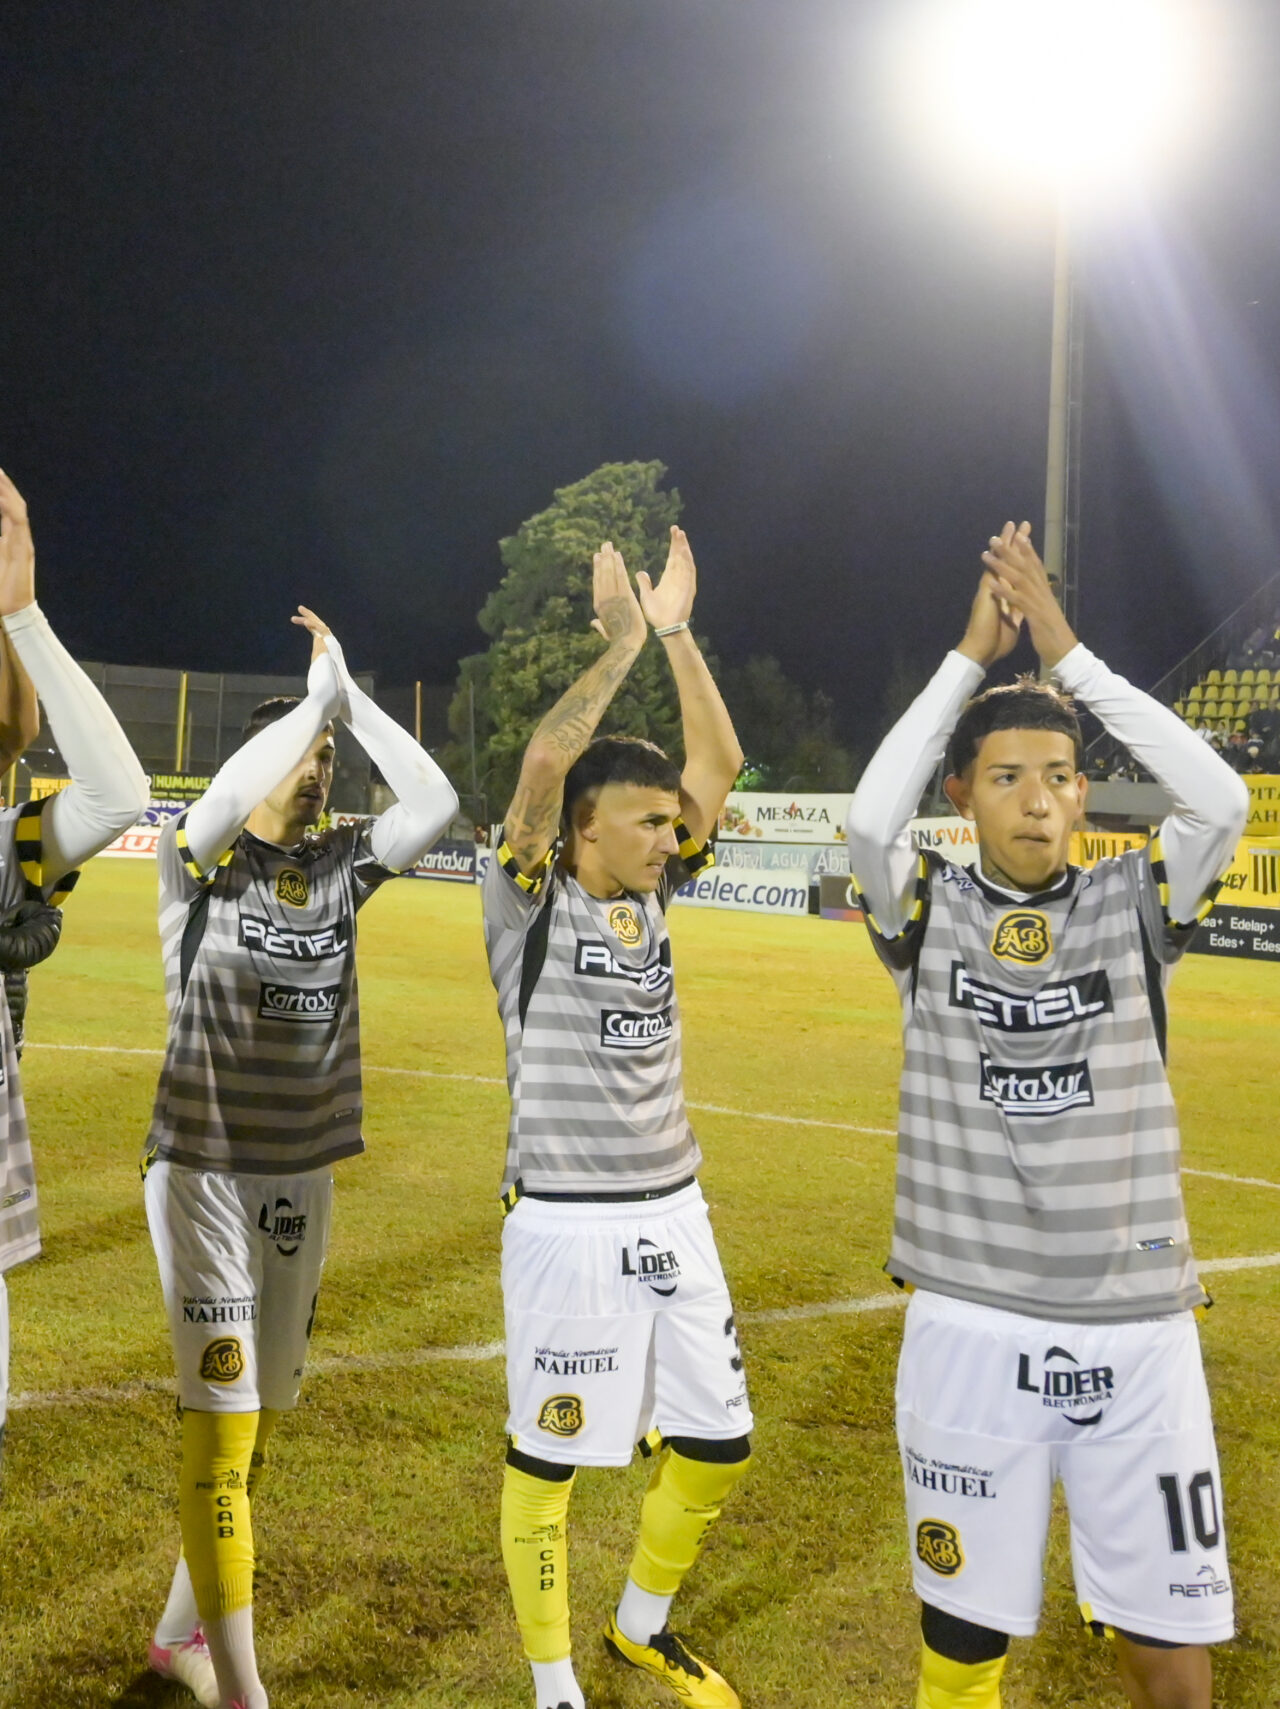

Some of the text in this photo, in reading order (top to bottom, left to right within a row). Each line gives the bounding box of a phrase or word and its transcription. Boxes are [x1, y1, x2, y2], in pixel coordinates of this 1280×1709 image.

[156, 775, 210, 790] HUMMUS
[771, 852, 809, 868] AGUA
[1230, 916, 1268, 935] Edelap
[1209, 932, 1238, 949] Edes
[265, 986, 338, 1012] CartaSu
[606, 1012, 670, 1037] Carta
[621, 1246, 680, 1276] LDER
[182, 1304, 257, 1323] NAHUEL
[534, 1356, 619, 1375] NAHUEL
[1017, 1352, 1114, 1398] LIDER
[1156, 1468, 1220, 1555] 10
